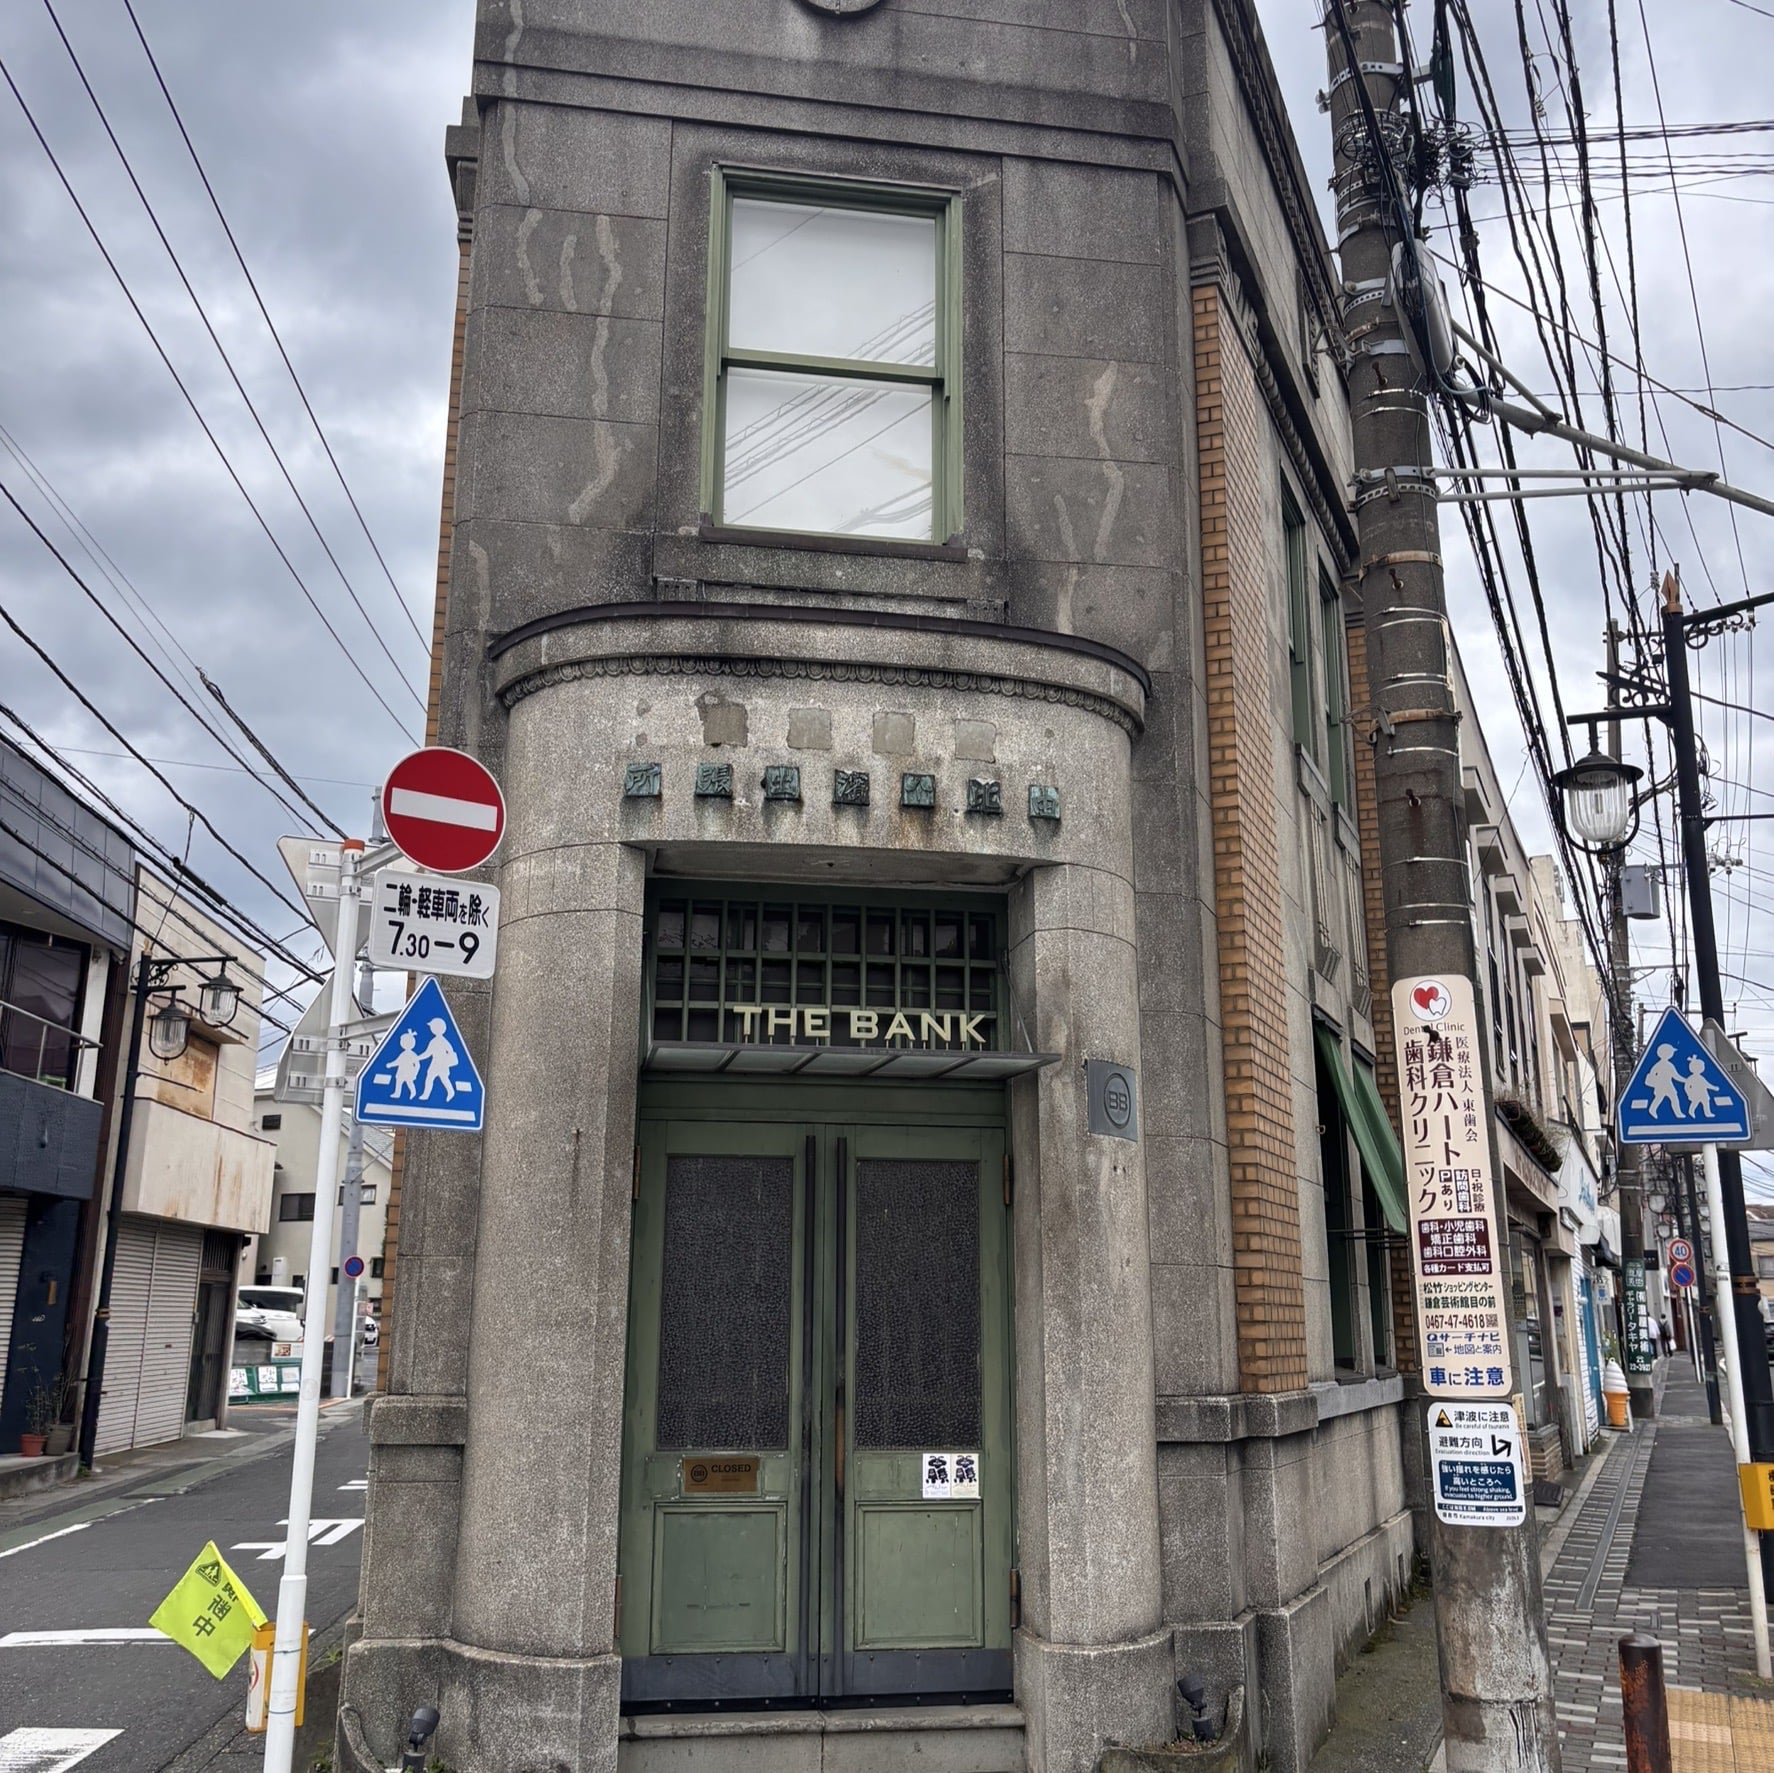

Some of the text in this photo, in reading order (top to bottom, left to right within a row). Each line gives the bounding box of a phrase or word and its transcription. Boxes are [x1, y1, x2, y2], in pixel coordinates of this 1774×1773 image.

[383, 882, 490, 928] 二輪・軽車両を除く
[733, 1006, 987, 1044] THE BANK
[1403, 1022, 1465, 1035] Denl Clinic
[1455, 1036, 1478, 1143] 医療法人 東歯会
[1403, 1039, 1437, 1214] 歯科クリニック
[1455, 1169, 1471, 1213] 訪問歯科
[1421, 1220, 1485, 1234] 歯科・小児歯科
[1431, 1232, 1477, 1245] 矯正歯科
[1423, 1245, 1487, 1258] 歯科口腔外科
[1674, 1245, 1687, 1257] 40
[1424, 1262, 1490, 1273] 各種カード支払可
[1425, 1296, 1496, 1309] 鎌倉芸術館目の前
[1425, 1314, 1485, 1329] 0467-47-4618
[1454, 1344, 1502, 1355] 地図と案内
[1430, 1366, 1505, 1386] 車に注意
[1454, 1411, 1510, 1422] 津波に注意
[1438, 1436, 1483, 1449] 避難方向
[711, 1464, 751, 1473] CLOSED
